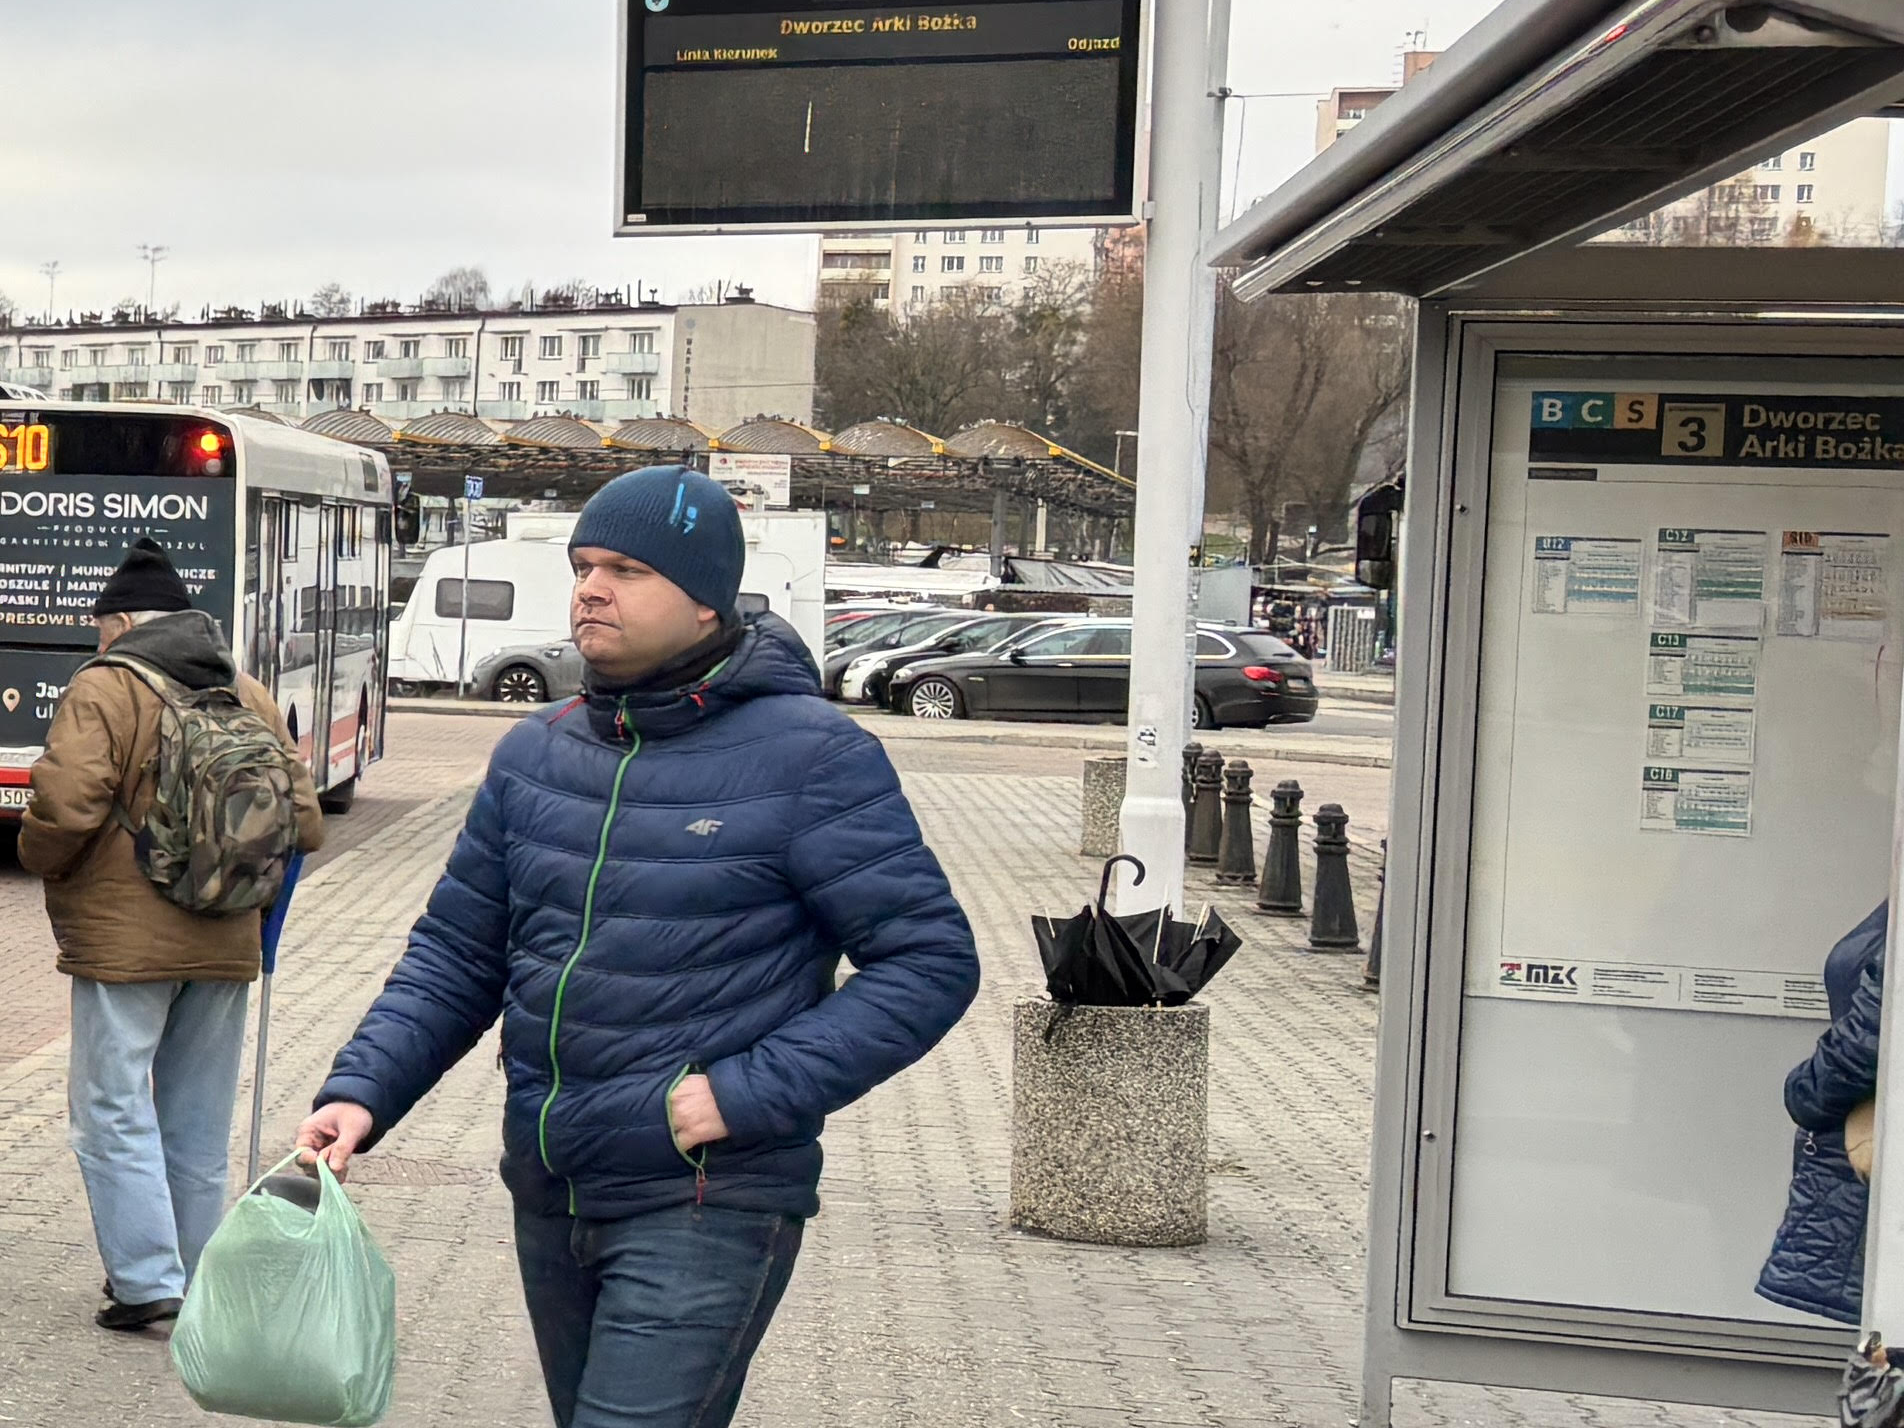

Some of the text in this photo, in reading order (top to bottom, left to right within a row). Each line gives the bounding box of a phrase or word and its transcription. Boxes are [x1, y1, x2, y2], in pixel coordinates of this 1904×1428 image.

[780, 19, 865, 35] Dworzec
[870, 14, 911, 33] Arki
[713, 46, 779, 61] Kierunek
[1541, 398, 1645, 424] B C S
[1742, 404, 1882, 430] Dworzec
[1677, 416, 1707, 453] 3
[1740, 434, 1805, 458] Arki
[0, 491, 208, 520] DORIS SIMON
[53, 524, 150, 535] PRODUCENT
[0, 594, 39, 606] PASKI
[685, 818, 724, 836] 4F
[1525, 963, 1579, 986] MZK
